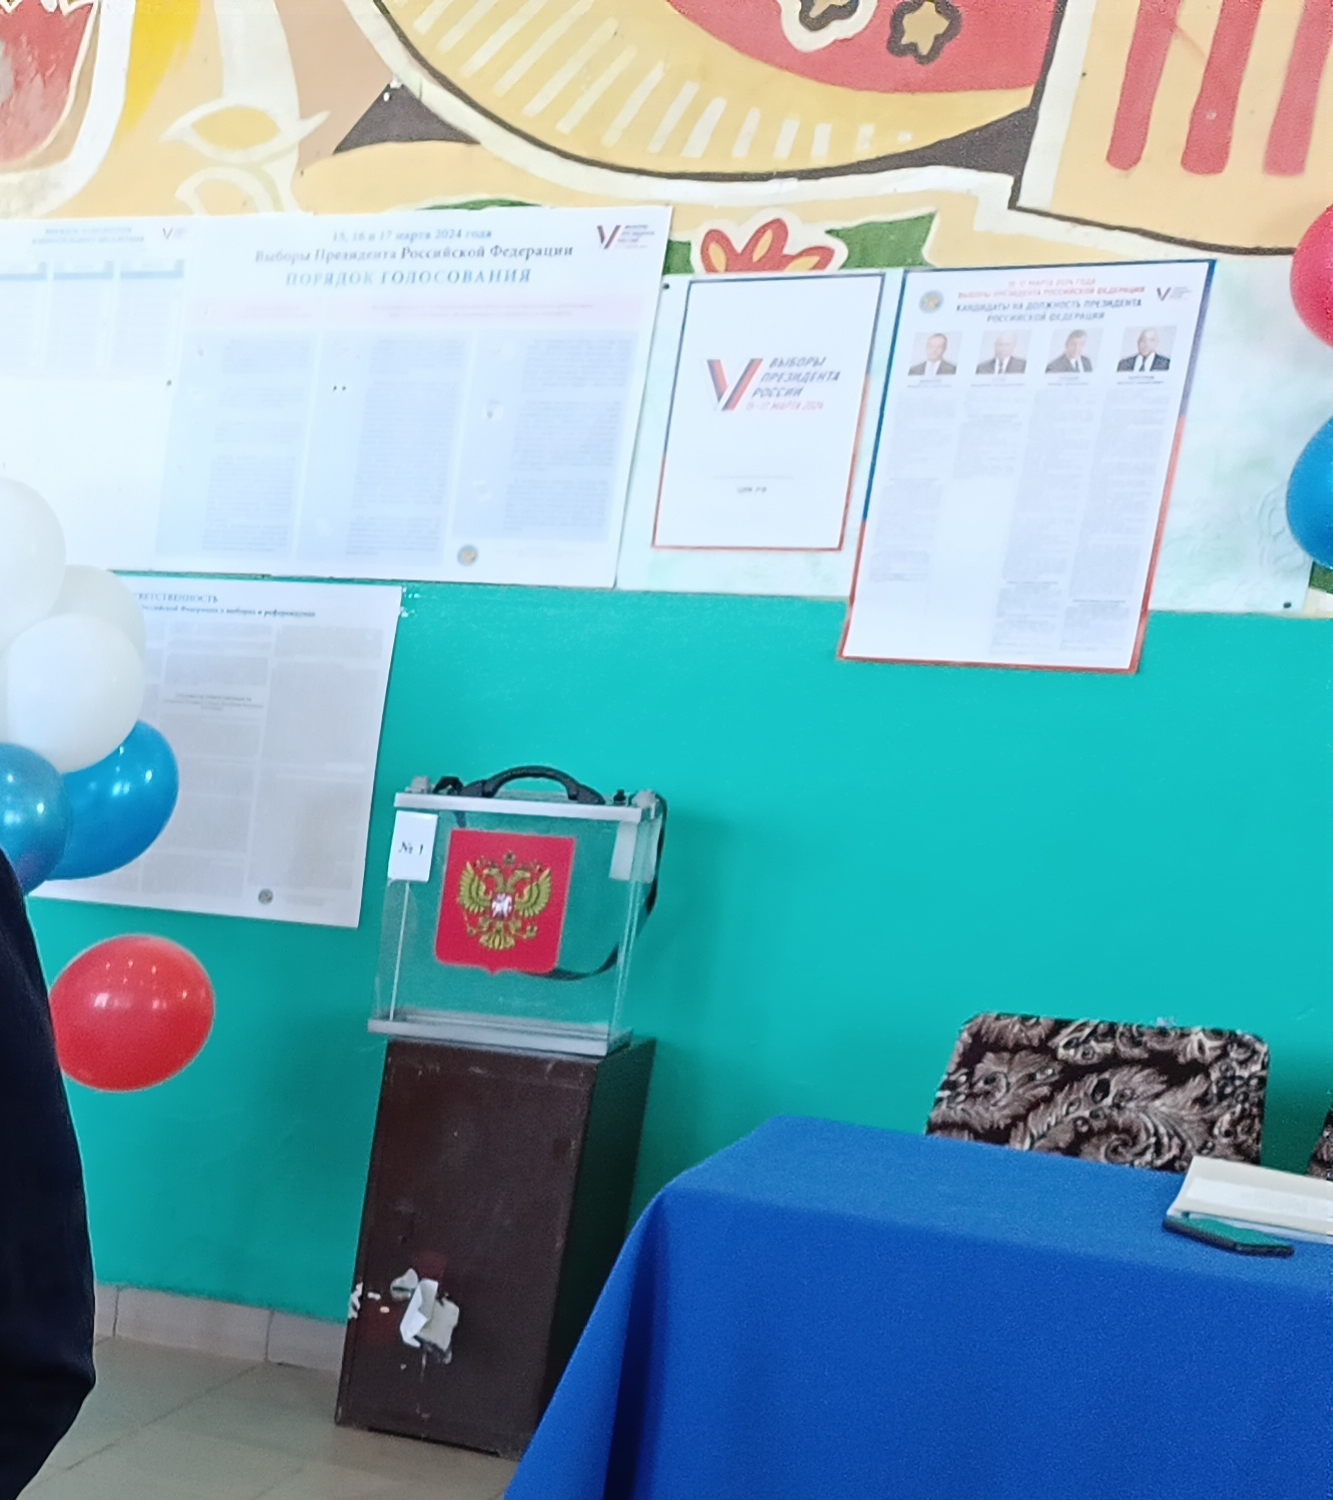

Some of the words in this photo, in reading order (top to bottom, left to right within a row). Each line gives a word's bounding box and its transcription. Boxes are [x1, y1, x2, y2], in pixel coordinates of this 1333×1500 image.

[255, 249, 311, 265] Выборы
[315, 247, 397, 264] Президента
[400, 245, 486, 260] Российской
[490, 243, 574, 261] Федерации
[381, 268, 531, 286] ГОЛОСОВАНИЯ
[769, 356, 826, 368] ВЫБОРЫ
[760, 371, 840, 383] ПРЕЗИДЕНТА
[751, 386, 803, 398] РОССИИ
